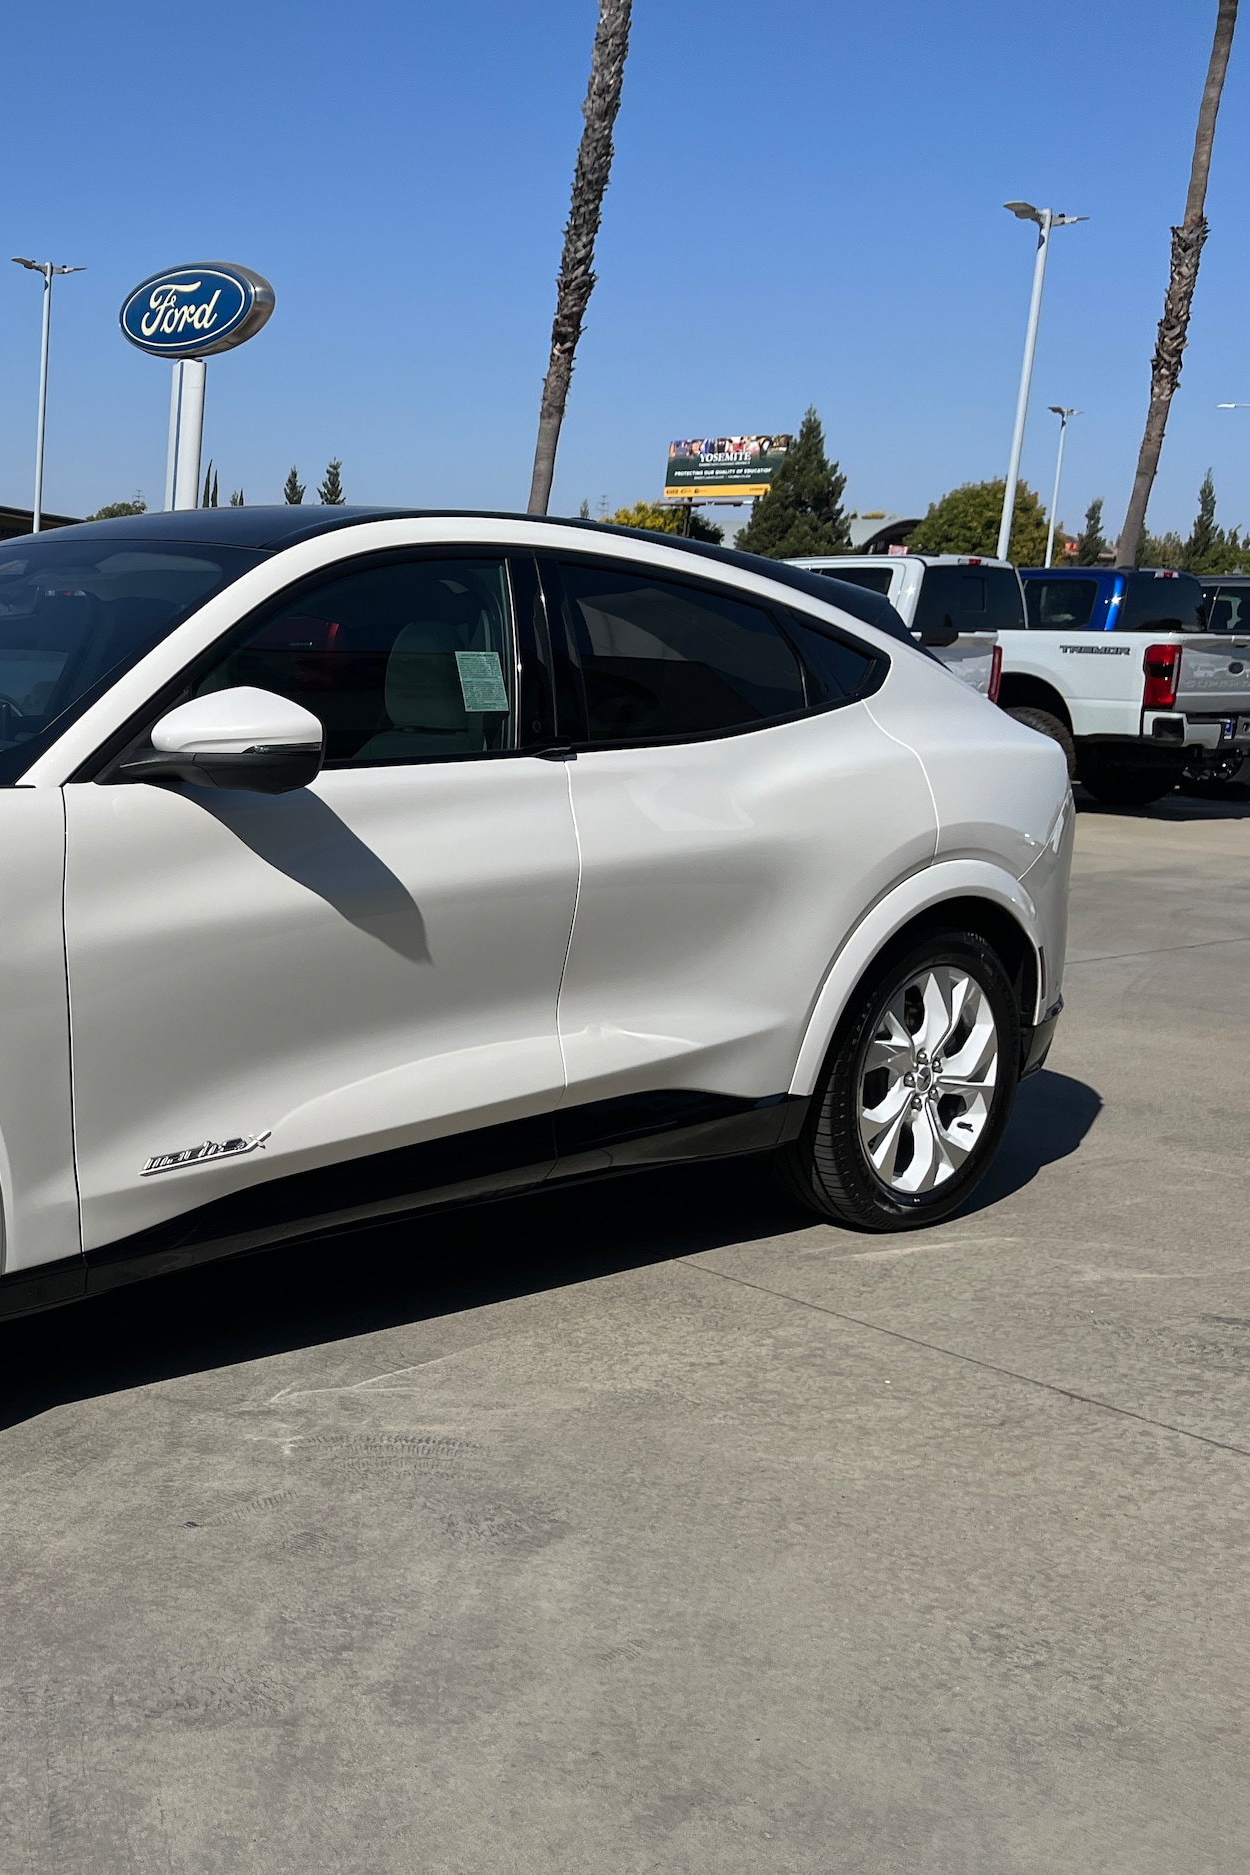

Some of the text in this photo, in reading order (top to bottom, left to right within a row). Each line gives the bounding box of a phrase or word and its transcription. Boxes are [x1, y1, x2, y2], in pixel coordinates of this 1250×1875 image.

[141, 281, 221, 336] Ford
[699, 452, 751, 462] YOSEMITE
[1059, 645, 1131, 656] TREMOR
